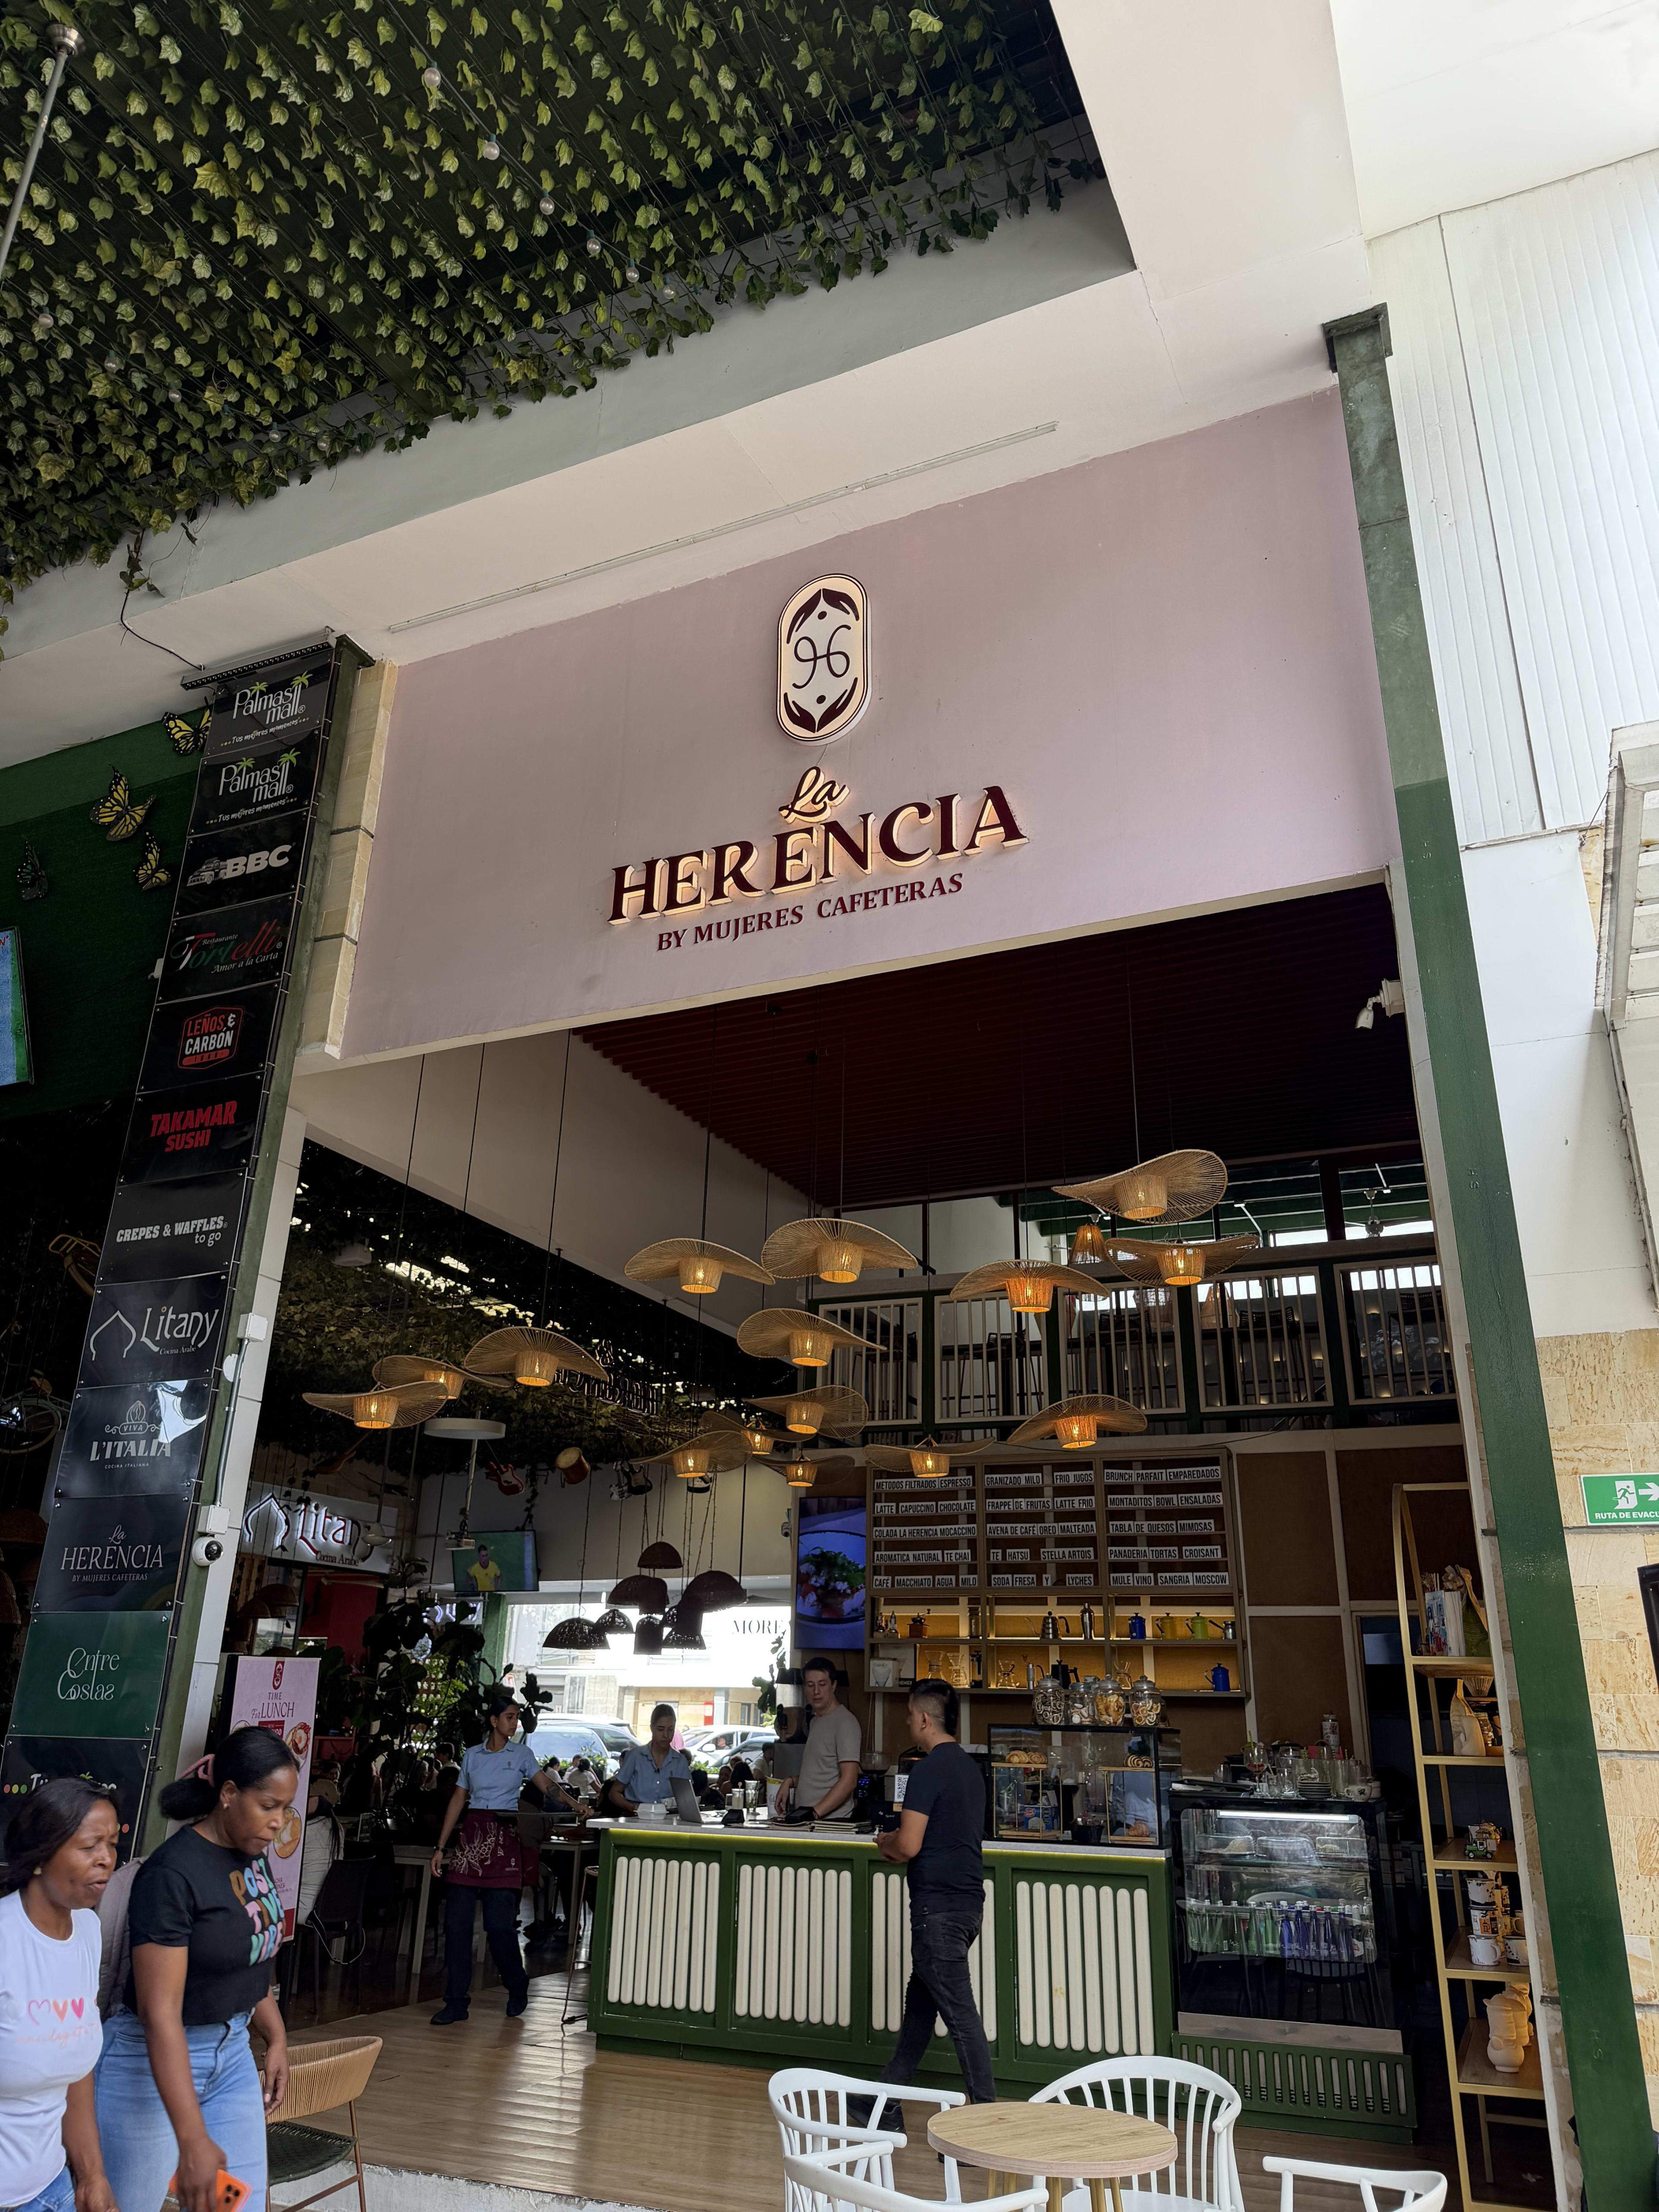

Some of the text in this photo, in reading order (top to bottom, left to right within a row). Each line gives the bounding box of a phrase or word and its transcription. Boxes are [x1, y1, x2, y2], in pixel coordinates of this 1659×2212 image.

[233, 688, 292, 719] Palmas
[232, 719, 298, 744] Tus mejores momentos
[219, 765, 280, 796] Palmas
[779, 766, 850, 823] La
[231, 808, 254, 818] mejores
[256, 799, 286, 811] momentos
[226, 845, 292, 879] BBC
[607, 786, 1029, 925] HERENCIA
[657, 873, 963, 951] BY MUJERES CAFETERAS
[202, 934, 238, 945] Restaurante
[211, 962, 237, 973] Amor
[245, 957, 253, 966] la
[255, 951, 278, 963] Carta
[187, 1013, 236, 1036] LEÑOS &
[184, 1027, 234, 1055] CARBÓN
[150, 1101, 237, 1137] TAKAMAR
[165, 1129, 210, 1152] SUSHI
[116, 1225, 159, 1243] CREPES
[163, 1224, 171, 1237] &
[195, 1231, 221, 1247] to go
[140, 1306, 219, 1352] Litany
[986, 1473, 1093, 1485] GRANIZADO MILO FRIO JUGOS
[1106, 1468, 1219, 1481] BRUNCH PARFAIT EMPAREDADOS
[876, 1478, 970, 1490] METODOS FILTRADOS ESPRESSO
[900, 1504, 934, 1513] CAPUCCINO
[939, 1502, 974, 1512] CHOCOLATE
[988, 1499, 1093, 1510] FRAPPE DE FRUTAS LATTE FRIO
[1109, 1495, 1220, 1506] MONTADITOS BOWL ENSALADAS
[109, 1525, 127, 1545] La
[874, 1526, 976, 1538] COLADA LA HERENCIA MOCACCINO
[988, 1524, 1094, 1535] AVENA DE CAFÉ OREO MALTEADA
[1111, 1522, 1212, 1532] TABLA DE QUESOS MIMOSAS
[60, 1545, 163, 1570] HERENCIA
[316, 1551, 336, 1564] Cocina
[876, 1552, 969, 1562] AROMATICA NATURAL TE CHAI
[992, 1550, 1091, 1560] TE HATSU STELLA ARTOIS
[1110, 1548, 1219, 1558] PANADERIA TORTAS CROISANT
[82, 1574, 110, 1583] MUJERES
[874, 1577, 976, 1587] CAFÉ MACCHIATO AGUA MILO
[993, 1576, 1092, 1586] SODA FRESA Y LYCHES
[1112, 1575, 1226, 1585] MULE VINO SANGRIA MOSCOW
[67, 1648, 119, 1678] Entre
[57, 1669, 114, 1700] Costas
[261, 1702, 295, 1718] LUNCH
